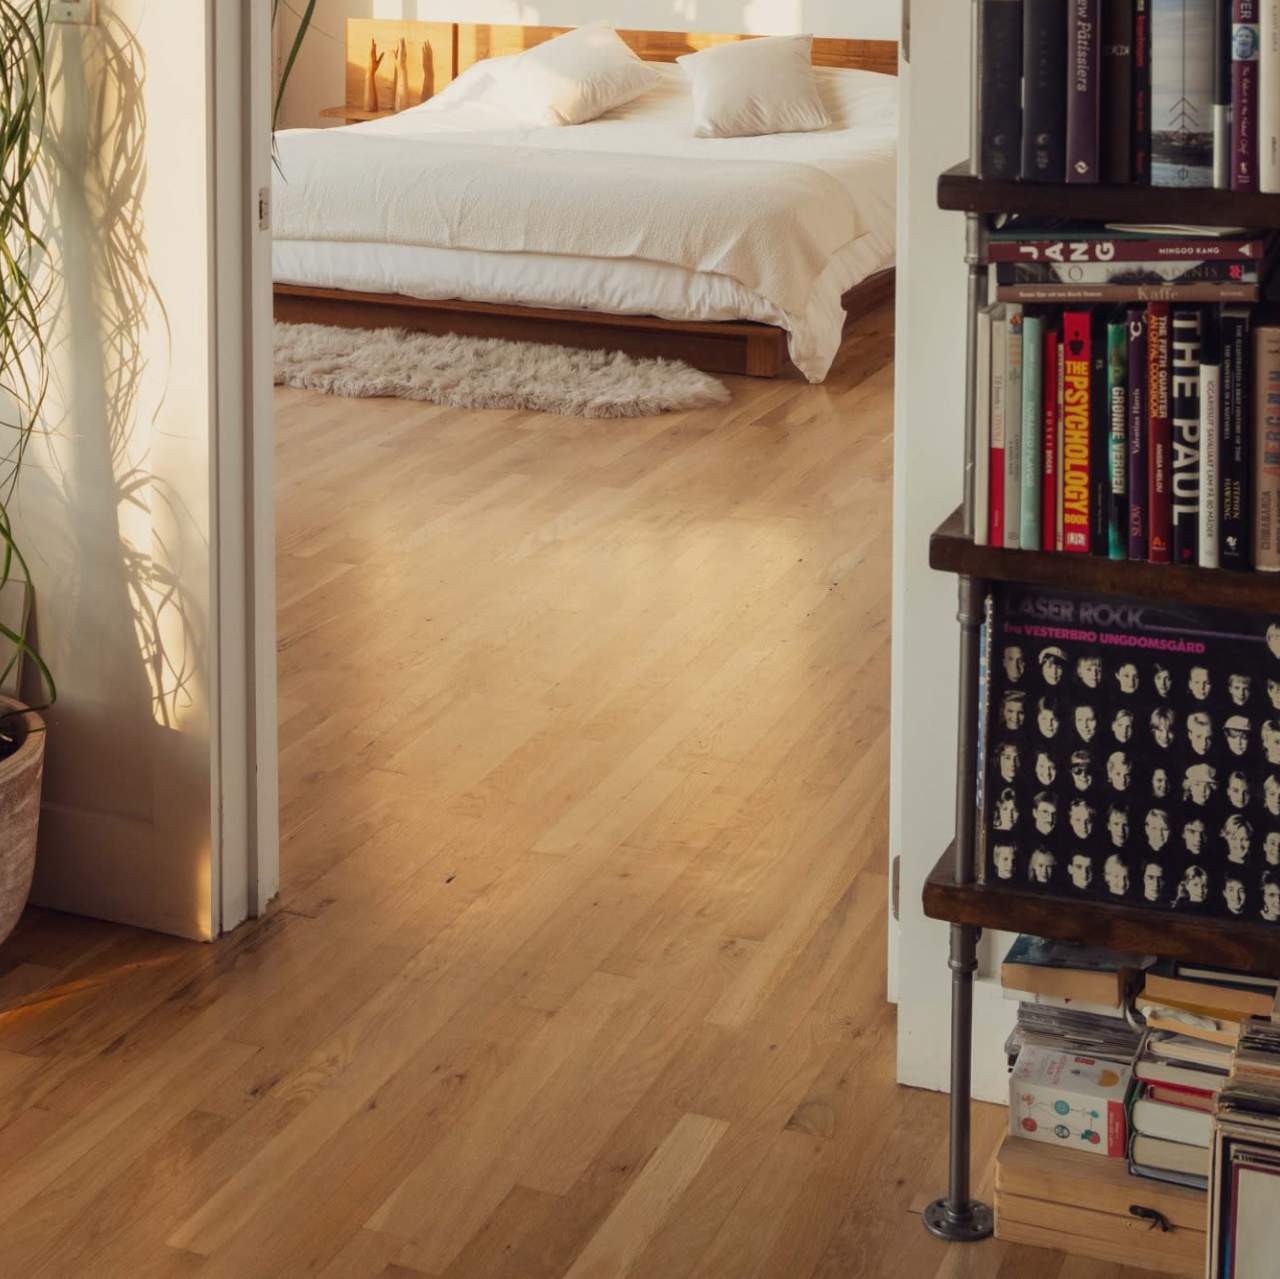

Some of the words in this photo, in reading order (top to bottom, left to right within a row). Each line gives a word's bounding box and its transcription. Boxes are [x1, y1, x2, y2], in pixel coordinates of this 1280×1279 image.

[1075, 20, 1093, 93] Pâtissiers
[1020, 240, 1116, 262] JANG
[1158, 246, 1193, 256] MINGOO
[1195, 246, 1220, 255] KANG
[1159, 315, 1168, 338] THE
[1065, 360, 1089, 375] THE
[1158, 338, 1168, 370] FIFTH
[1172, 313, 1200, 399] THE
[1111, 386, 1125, 440] GRØNNE
[1158, 370, 1167, 419] QUARTER
[1064, 375, 1089, 512] PSYCHOLOGY
[1111, 443, 1125, 495] VERDEN
[1171, 417, 1200, 528] PAUL
[1223, 478, 1233, 520] HAWKING
[1231, 480, 1241, 519] STEPHEN
[1004, 598, 1074, 623] LASER
[1079, 603, 1144, 628] ROCK
[1022, 625, 1097, 644] VESTERBRO
[1099, 631, 1206, 655] UNGDOMSGÅRD
